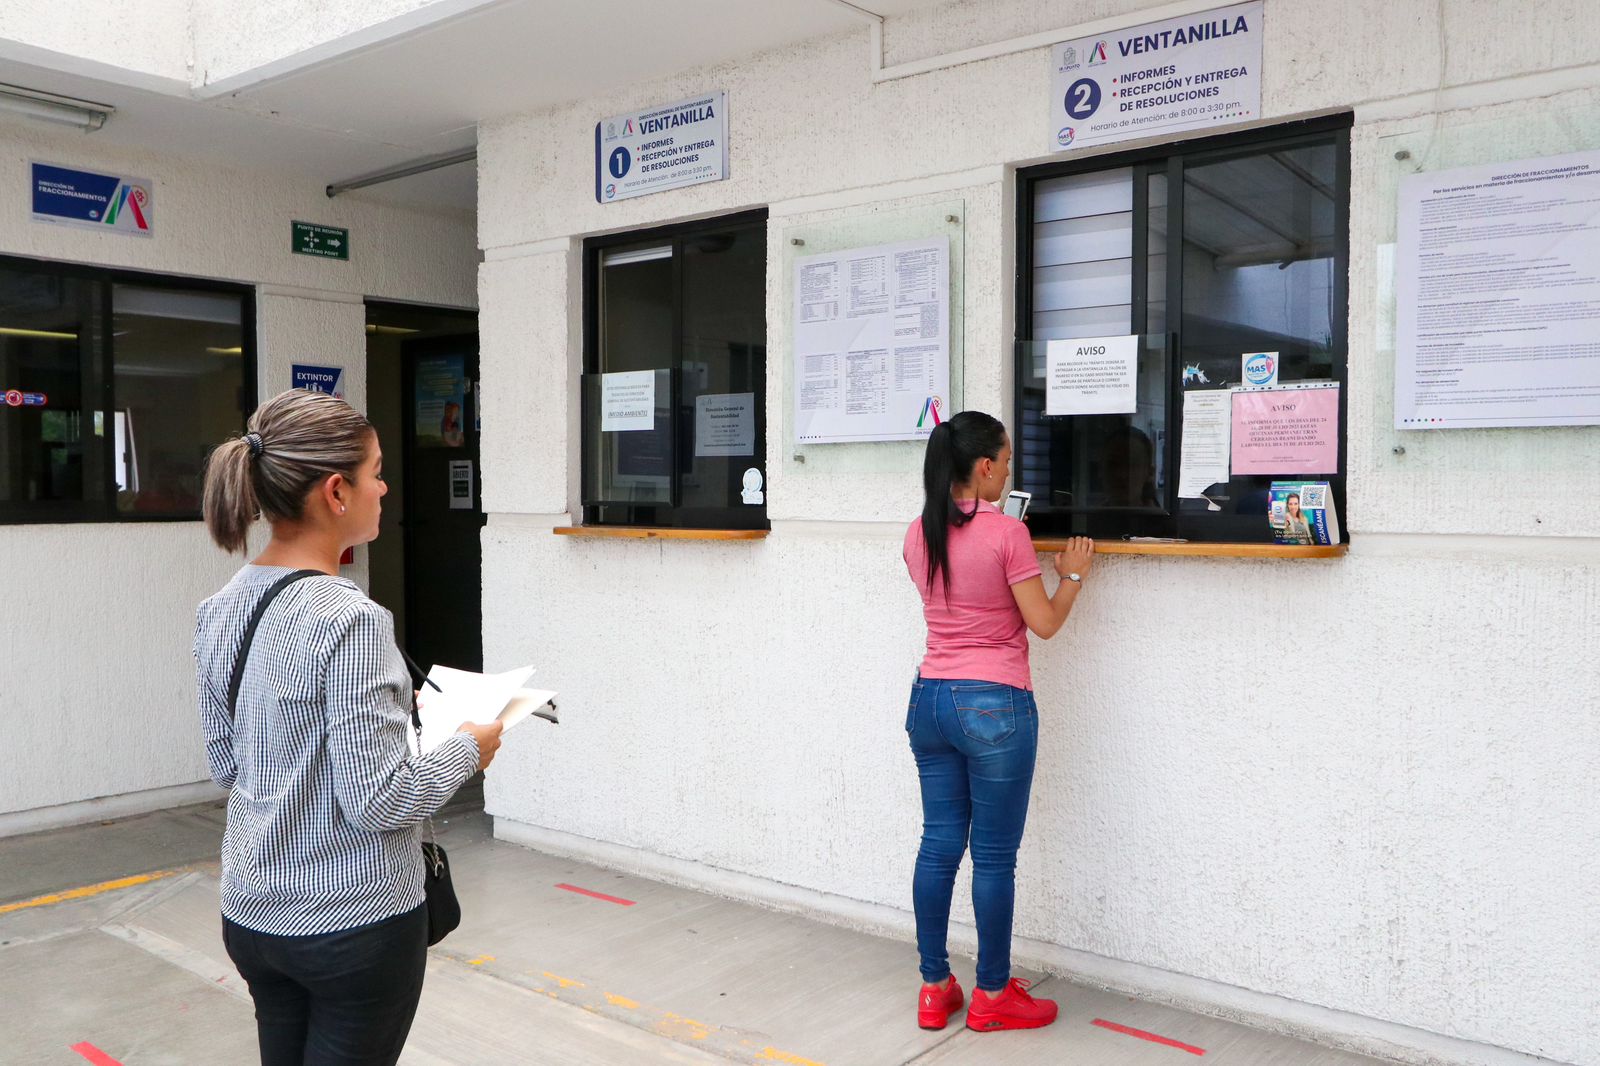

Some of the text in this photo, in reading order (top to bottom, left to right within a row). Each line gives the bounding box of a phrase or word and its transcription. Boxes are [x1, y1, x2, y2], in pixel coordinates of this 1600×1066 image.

[1118, 15, 1248, 57] VENTANILLA
[1120, 64, 1176, 84] INFORMES
[1120, 66, 1248, 98] RECEPCIÓN Y ENTREGA
[1074, 84, 1092, 113] 2
[1120, 86, 1219, 112] DE RESOLUCIONES
[639, 105, 714, 135] VENTANILLA
[1090, 118, 1118, 132] Horario
[1119, 118, 1130, 127] de
[1131, 112, 1167, 125] Atención:
[1168, 110, 1179, 119] de
[1180, 107, 1198, 117] 8:00
[1206, 102, 1224, 112] 3:30
[1225, 100, 1241, 111] pm.
[641, 137, 674, 151] INFORMES
[641, 147, 678, 162] RECEPCIÓN
[685, 139, 715, 153] ENTREGA
[616, 152, 623, 175] 1
[642, 154, 699, 173] DE RESOLUCIONES
[1491, 172, 1521, 181] DIRECCIÓN
[1530, 164, 1589, 176] FRACCIONAMIENTOS
[38, 186, 107, 202] FRACCIONAMIENTOS
[1076, 346, 1106, 356] AVISO
[297, 372, 334, 382] EXTINTOR
[1247, 365, 1266, 373] MAS
[1272, 404, 1296, 412] AVISO
